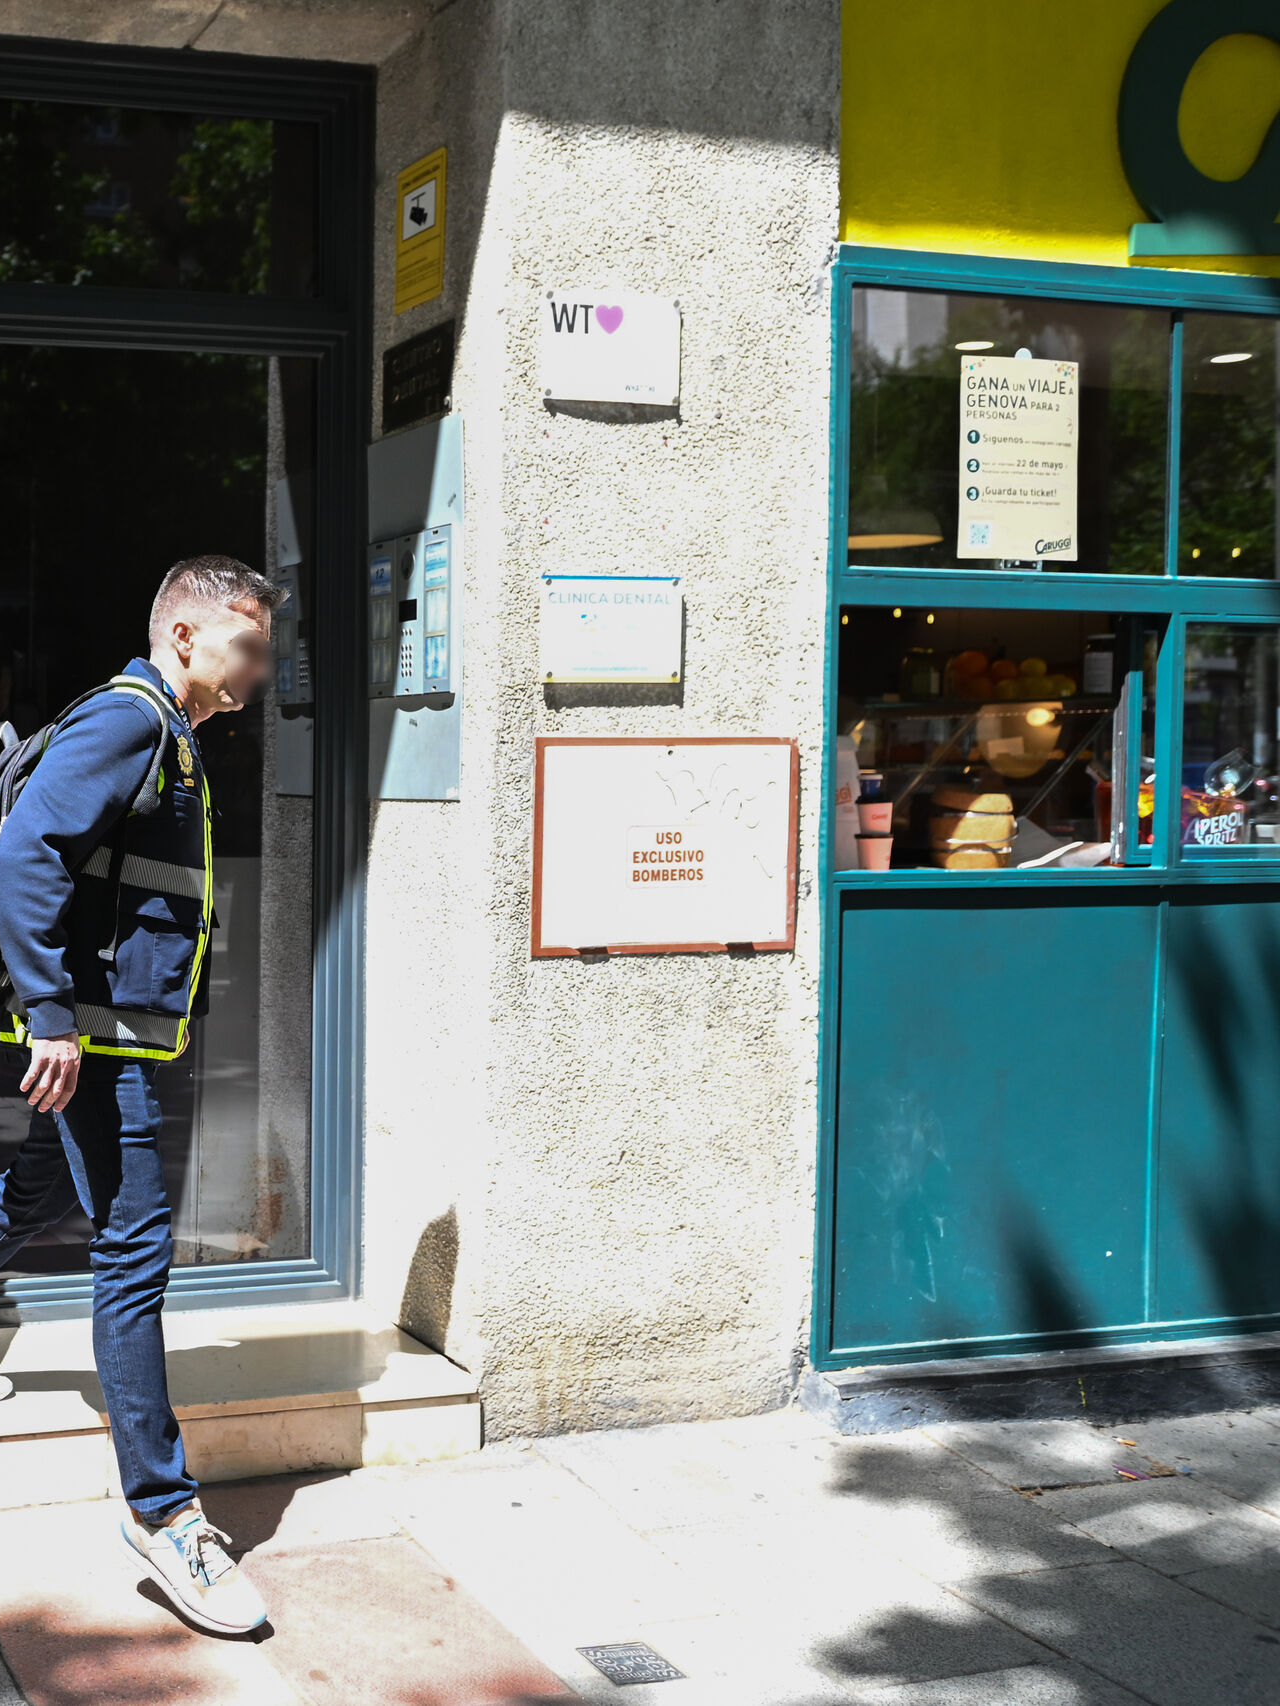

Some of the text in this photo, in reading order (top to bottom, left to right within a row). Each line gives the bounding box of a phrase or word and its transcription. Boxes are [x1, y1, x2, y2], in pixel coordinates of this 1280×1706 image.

[551, 301, 594, 334] WT
[967, 376, 1010, 391] GANA
[1013, 383, 1026, 391] UN
[1028, 378, 1066, 395] VIAJE
[1031, 401, 1053, 411] PARA
[1055, 404, 1060, 412] 2
[966, 410, 1017, 420] PERSONAS
[1016, 460, 1026, 468] 22
[1029, 459, 1039, 468] de
[1042, 460, 1063, 470] mayo
[1020, 488, 1028, 496] tu
[375, 568, 385, 580] 12
[548, 592, 672, 605] CLINICA DENTAL
[1184, 812, 1244, 841] APEROL
[655, 831, 683, 845] USO
[632, 849, 704, 864] EXCLUSIVO
[632, 868, 704, 882] BOMBEROS
